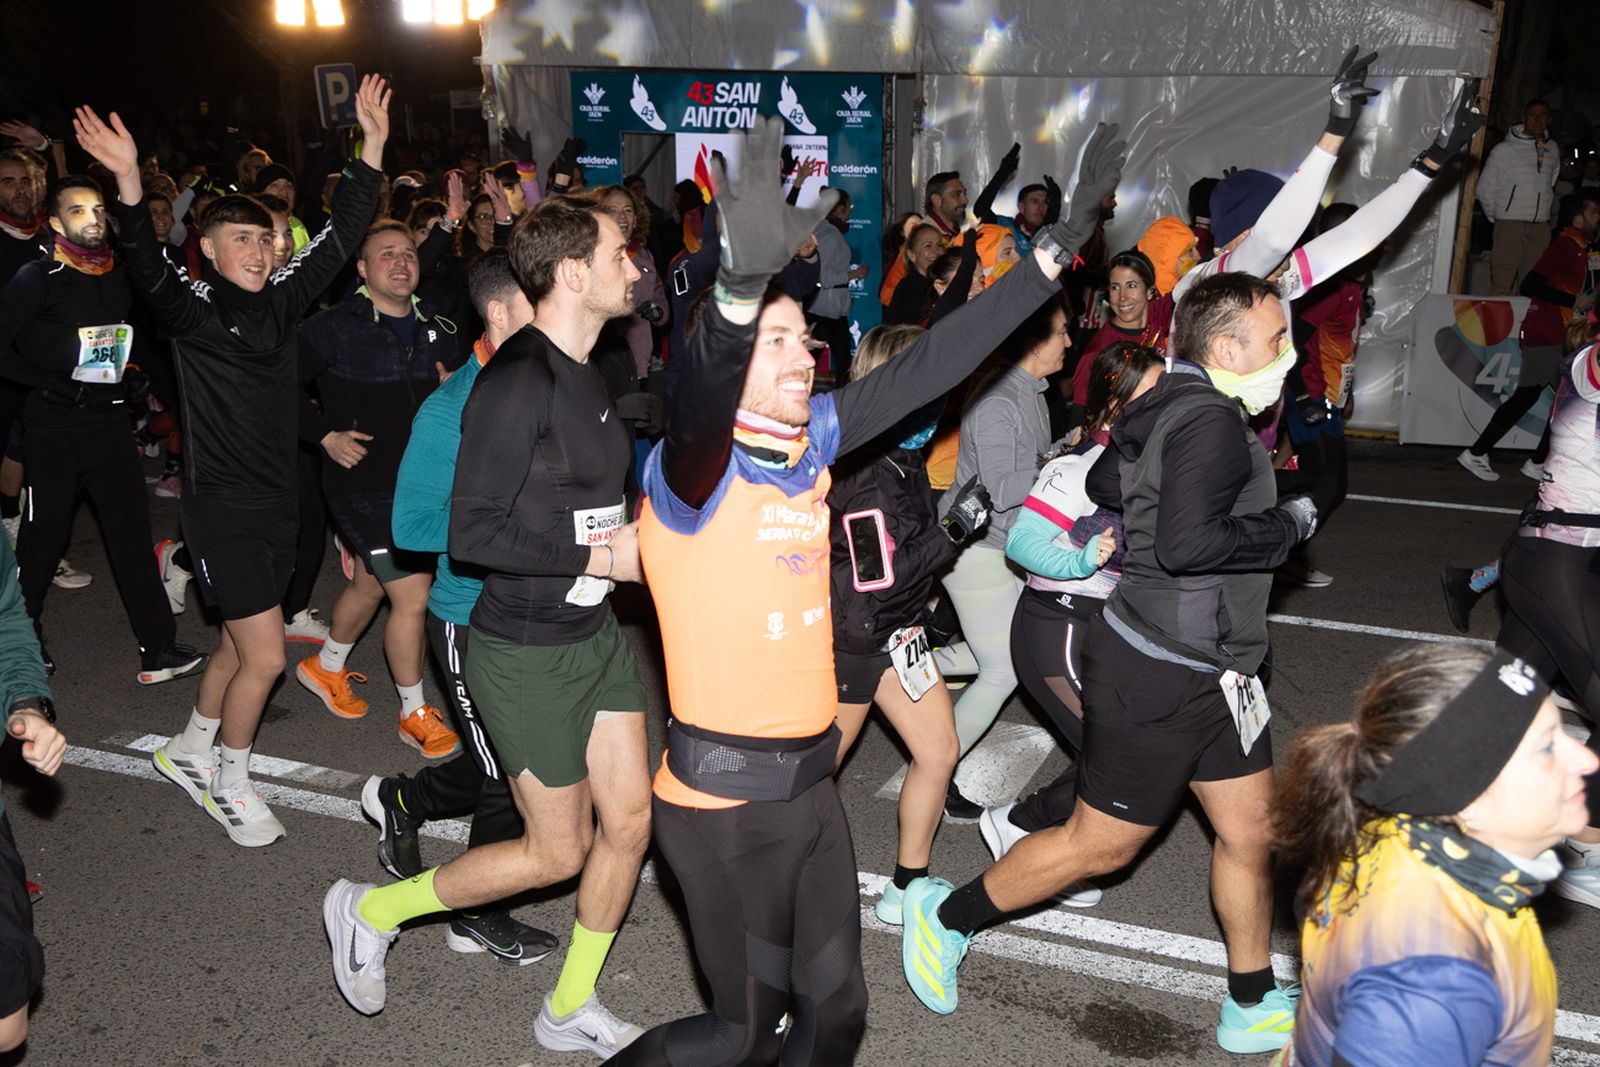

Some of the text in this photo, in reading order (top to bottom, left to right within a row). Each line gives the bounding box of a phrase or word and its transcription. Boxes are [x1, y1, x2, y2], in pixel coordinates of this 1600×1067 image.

[325, 71, 350, 121] P
[641, 105, 655, 122] 43
[681, 101, 757, 128] ANTÓN
[788, 108, 804, 125] 43
[597, 518, 618, 530] NOCHE
[587, 531, 602, 544] SAN
